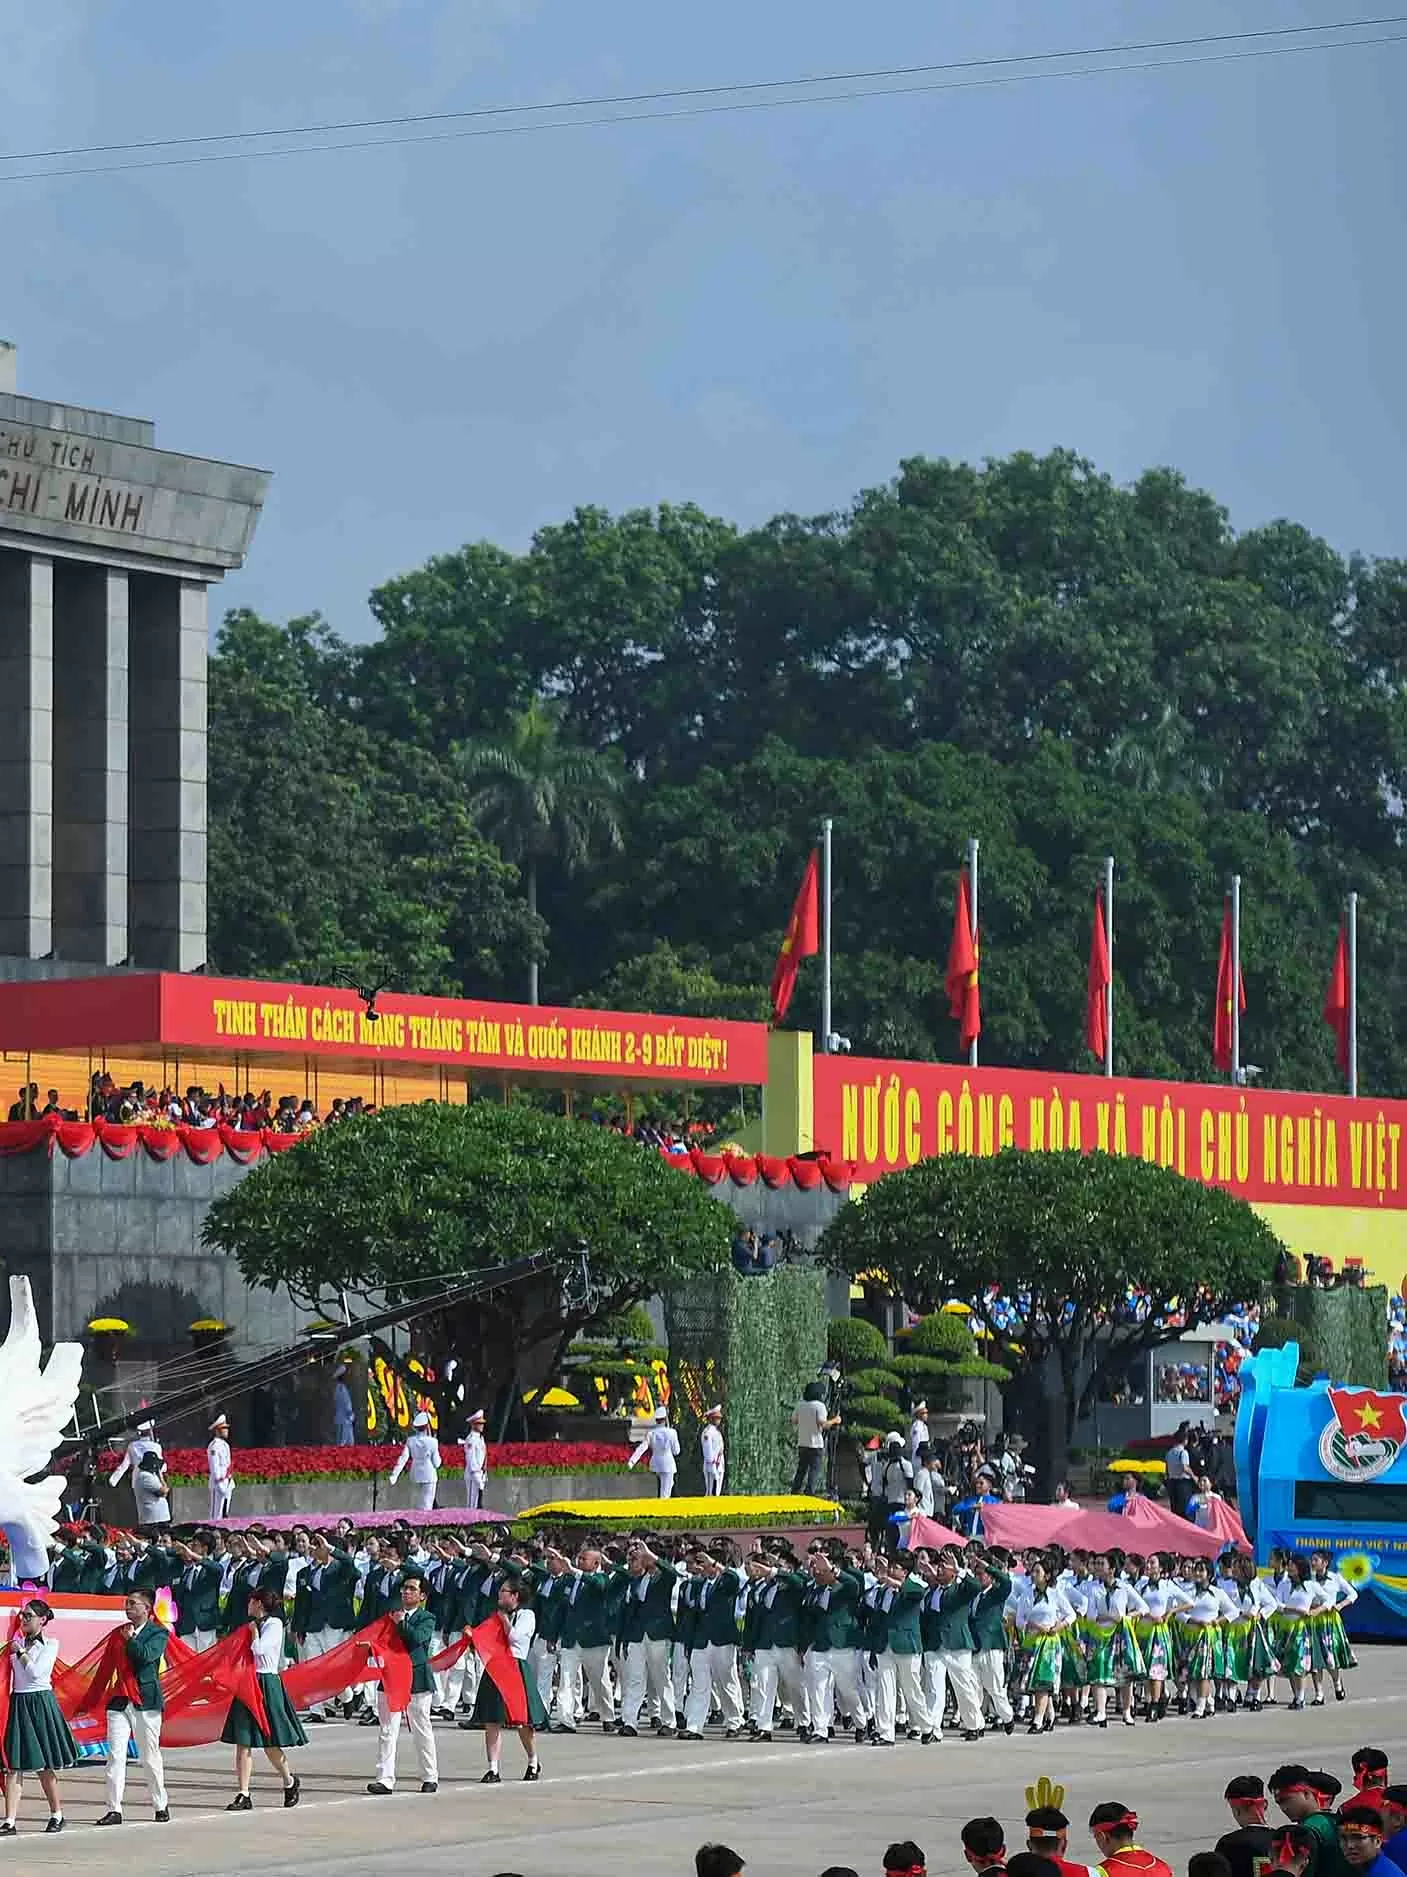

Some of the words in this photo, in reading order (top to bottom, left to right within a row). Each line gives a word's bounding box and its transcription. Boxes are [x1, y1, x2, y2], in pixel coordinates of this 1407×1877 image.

[213, 999, 256, 1036] TINH
[312, 1001, 355, 1043] CÁCH
[359, 1010, 405, 1052] MẠNG
[409, 1010, 462, 1052] THÁNG
[466, 1015, 500, 1055] TÁM
[504, 1016, 524, 1057] VÀ
[528, 1016, 567, 1060] QUỐC
[571, 1024, 621, 1063] KHÁNH
[625, 1031, 652, 1066] 2-9
[655, 1024, 685, 1067] BẤT
[842, 1073, 921, 1165] NƯỚC
[1029, 1087, 1081, 1153] HÒA
[1096, 1092, 1127, 1157] XÃ
[1200, 1095, 1249, 1184] CHỦ
[1263, 1107, 1337, 1187] NGHĨA
[1349, 1111, 1401, 1204] VIỆT
